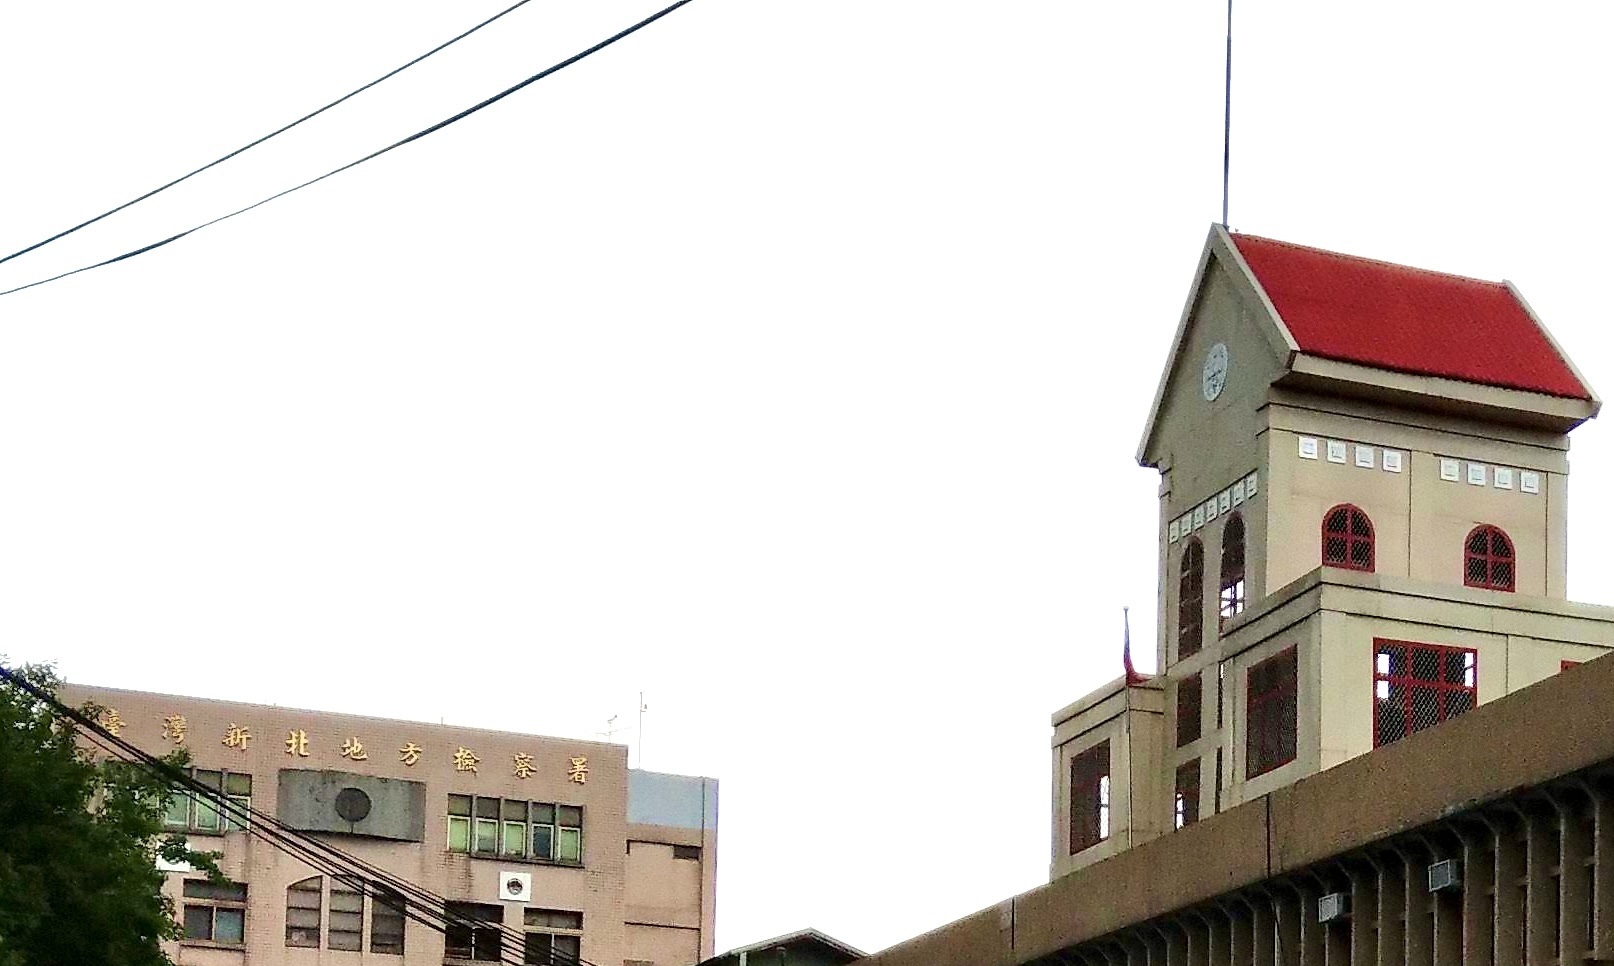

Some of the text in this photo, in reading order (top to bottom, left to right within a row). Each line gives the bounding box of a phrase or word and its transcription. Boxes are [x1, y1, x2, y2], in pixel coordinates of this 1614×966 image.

[101, 706, 590, 785] 臺灣新北地方檢察署
